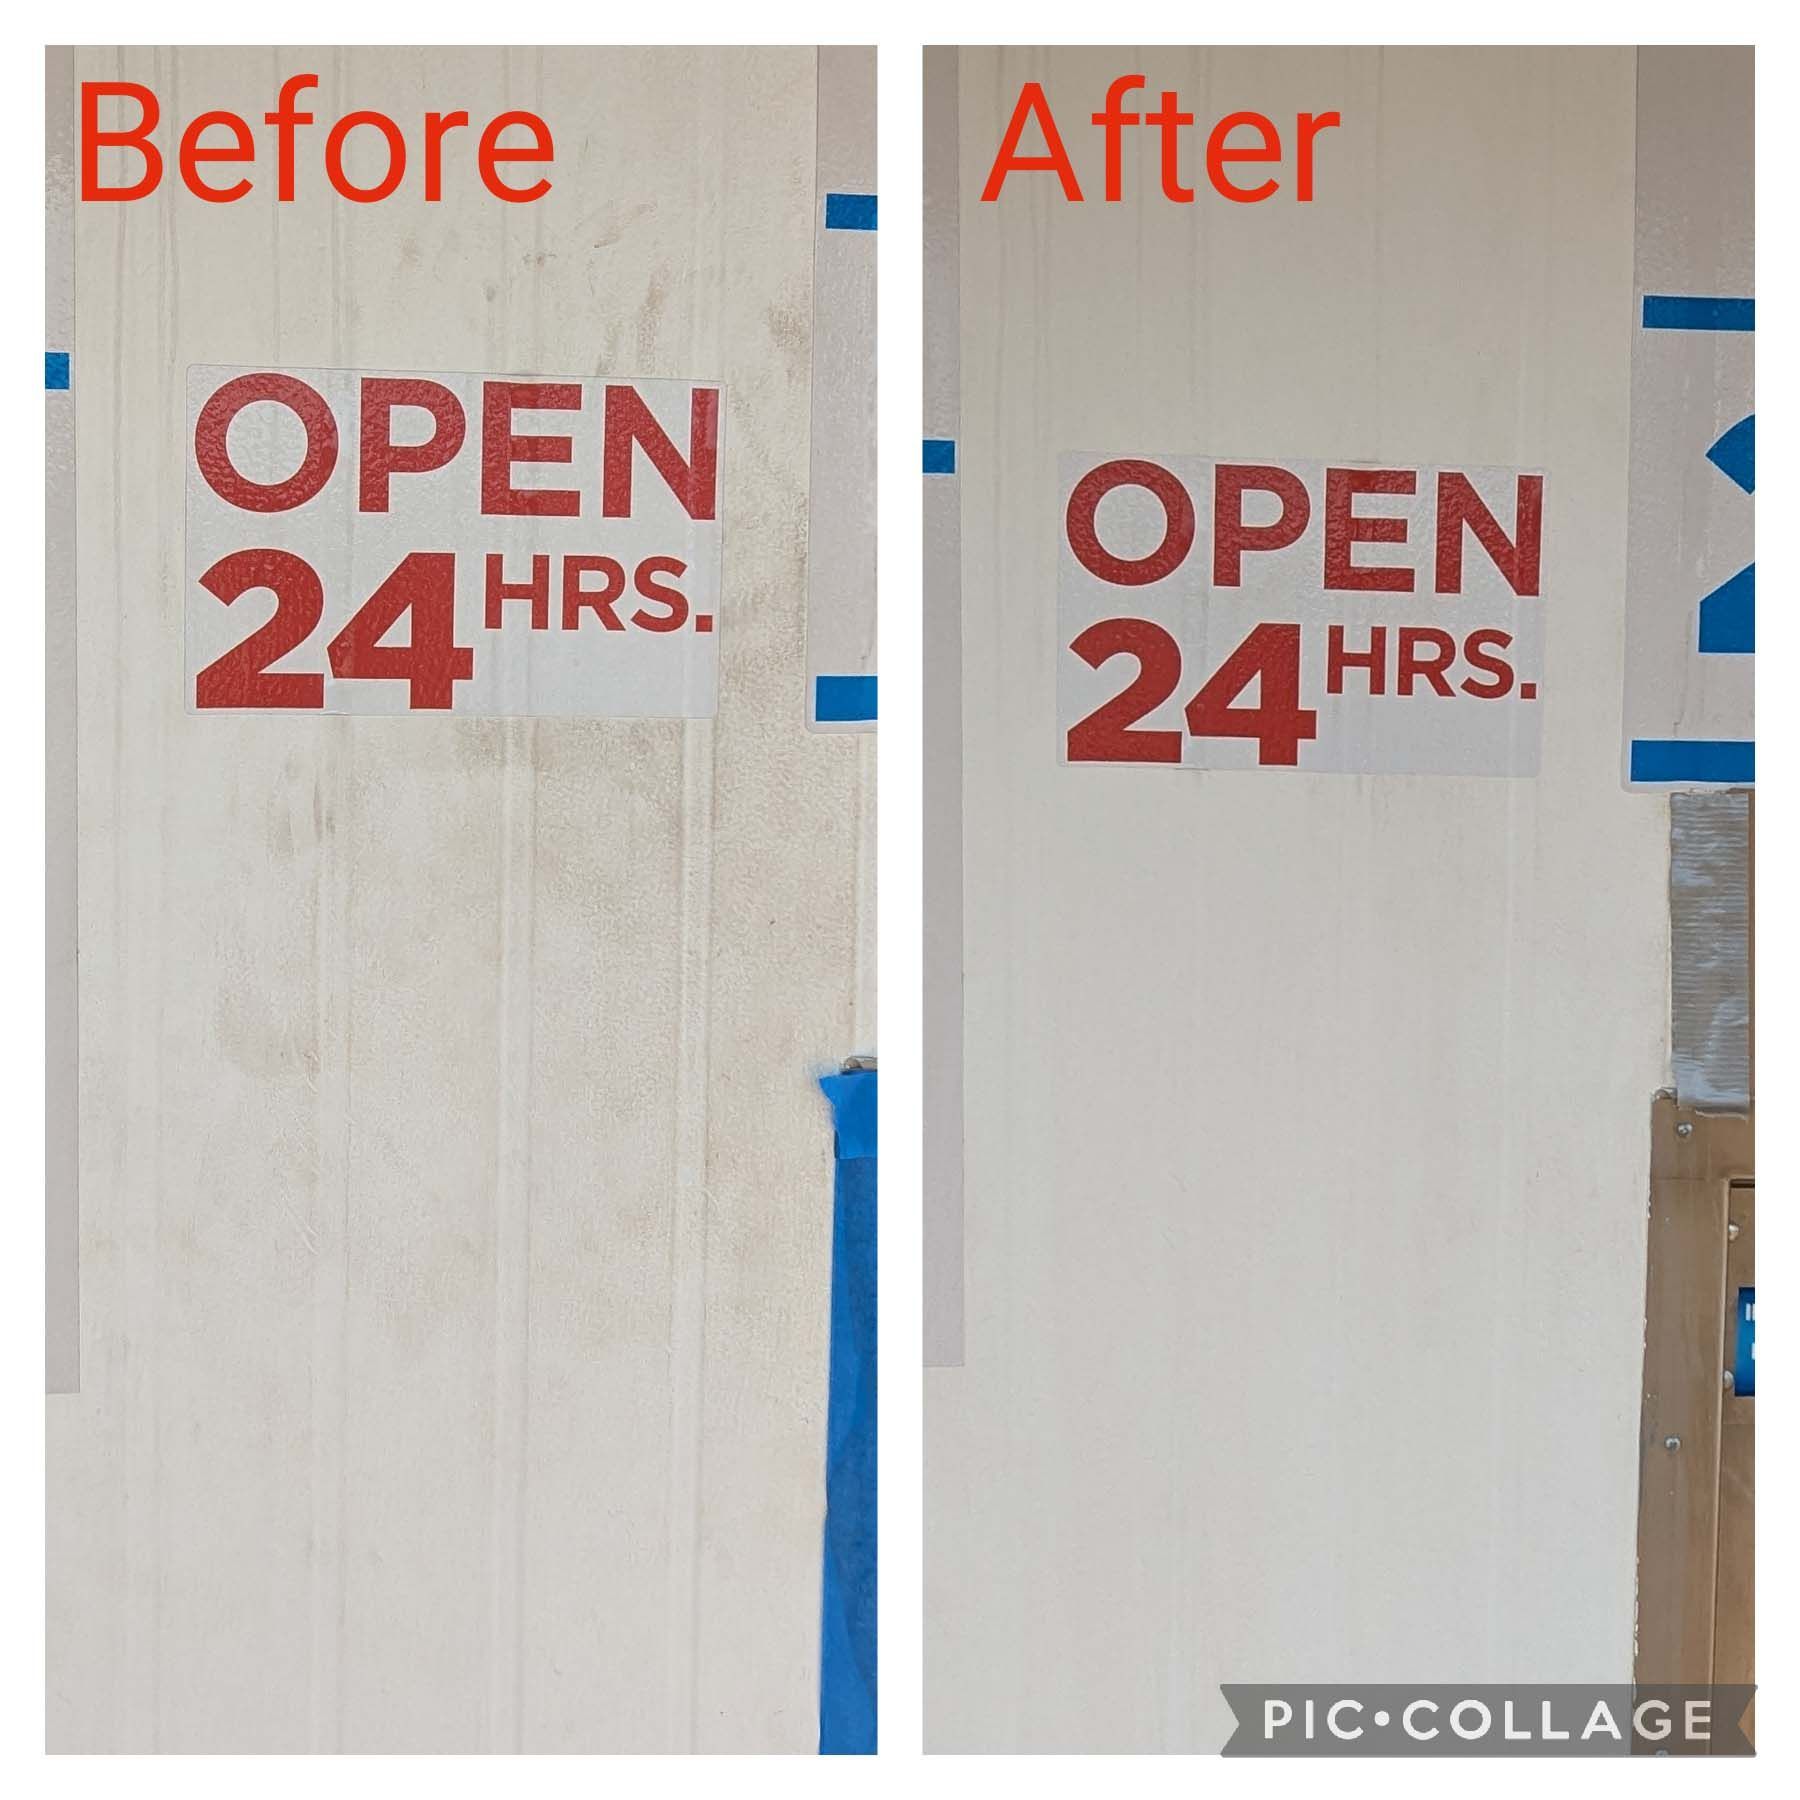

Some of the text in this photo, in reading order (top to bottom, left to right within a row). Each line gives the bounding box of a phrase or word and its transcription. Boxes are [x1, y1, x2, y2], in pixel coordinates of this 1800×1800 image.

[195, 374, 718, 520] OPEN
[1067, 461, 1542, 596] OPEN
[196, 549, 714, 710] 24 HRS.
[1067, 619, 1538, 766] 24 HRS.
